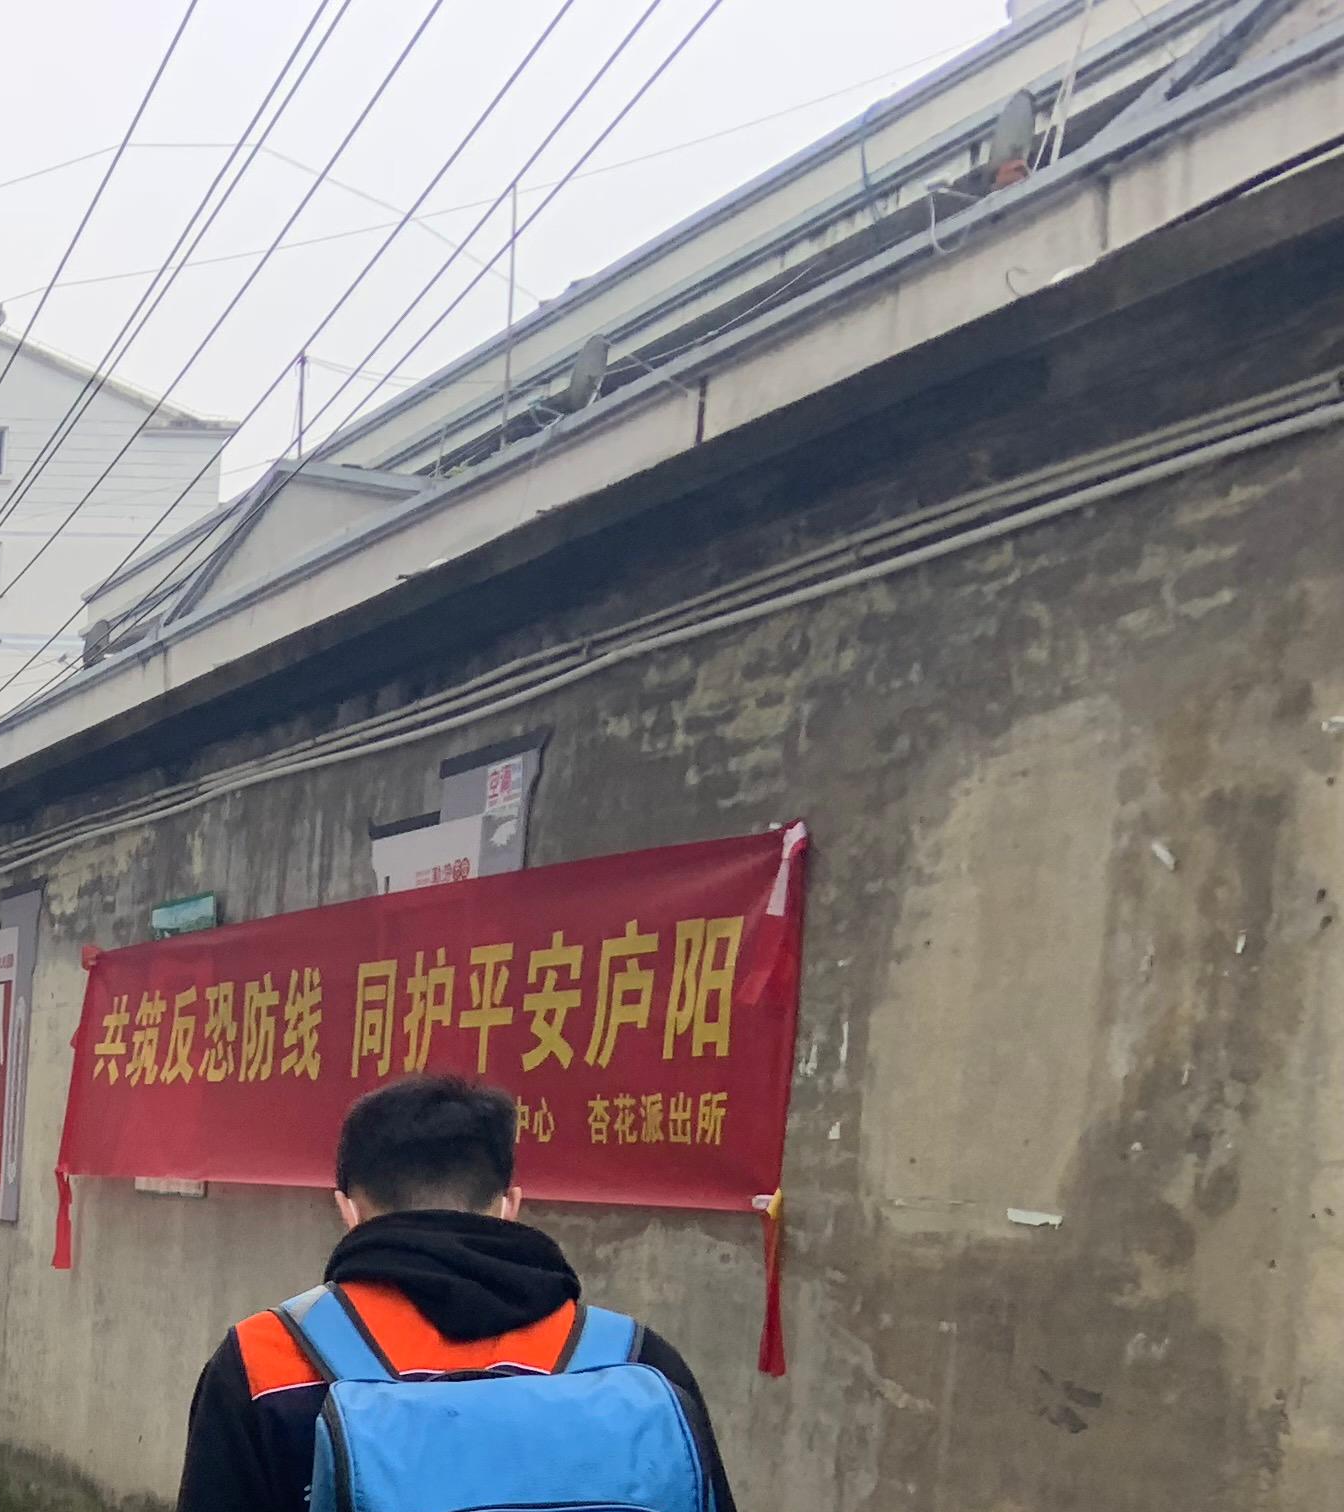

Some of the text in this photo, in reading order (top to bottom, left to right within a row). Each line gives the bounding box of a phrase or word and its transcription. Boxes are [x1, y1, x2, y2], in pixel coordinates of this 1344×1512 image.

[92, 914, 746, 1086] 共筑反恐防线 同护平安庐阳
[587, 1092, 729, 1145] 杏花派出所
